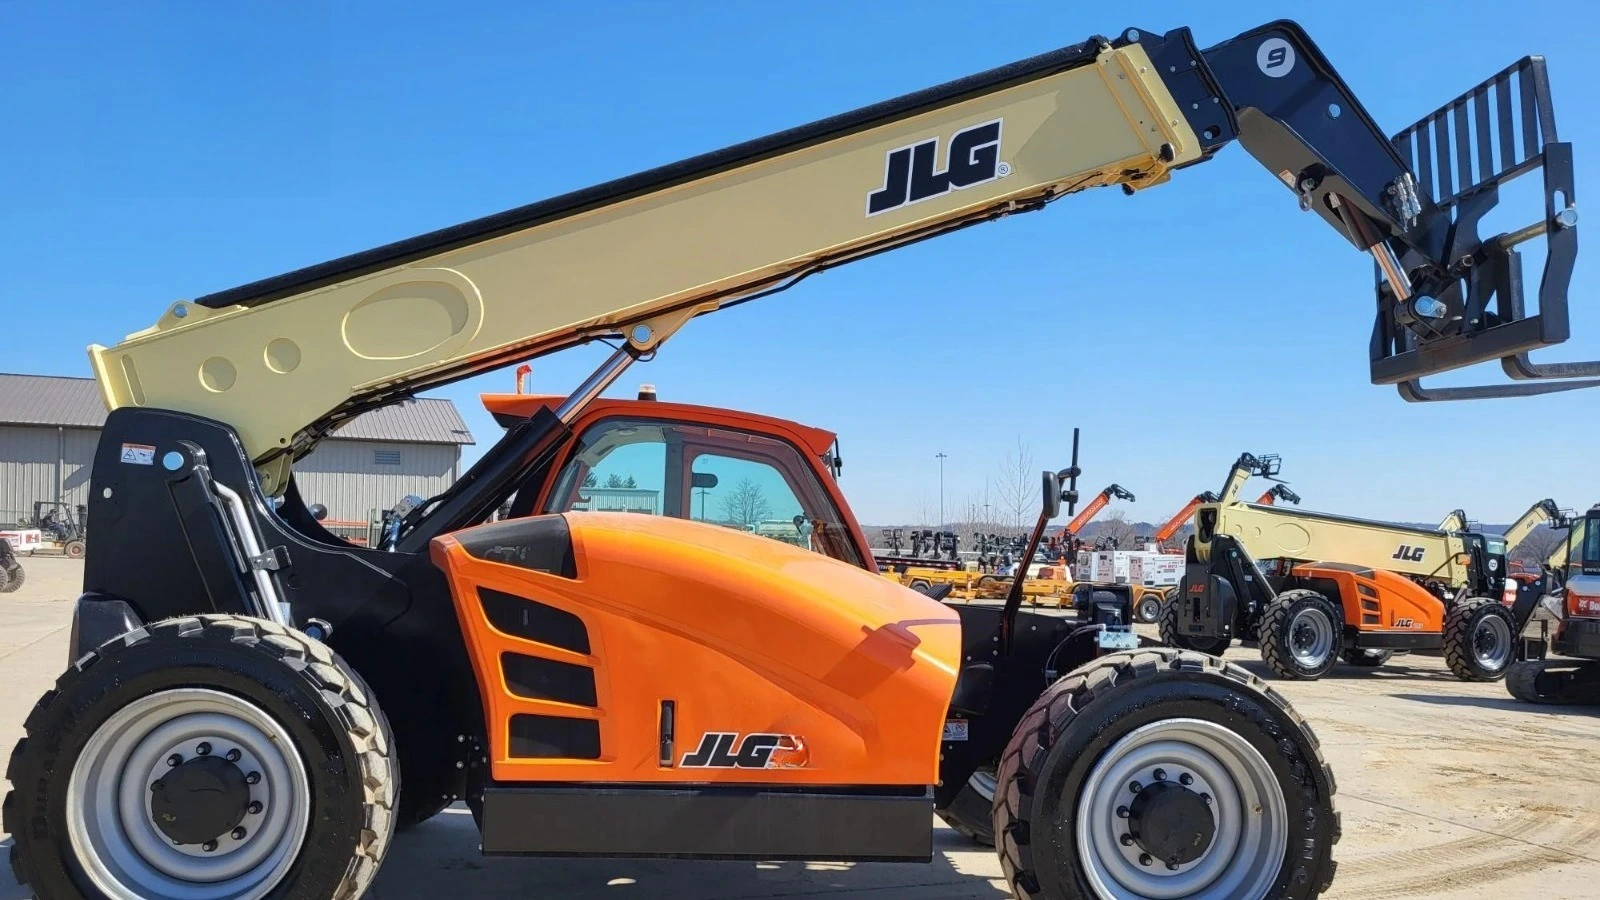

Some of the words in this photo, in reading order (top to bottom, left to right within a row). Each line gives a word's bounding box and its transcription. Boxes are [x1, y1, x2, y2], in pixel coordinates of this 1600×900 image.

[1266, 46, 1287, 69] 9
[1391, 544, 1426, 562] JLG
[1189, 584, 1205, 593] JLG
[1395, 618, 1413, 628] JLG
[680, 732, 780, 769] JLG
